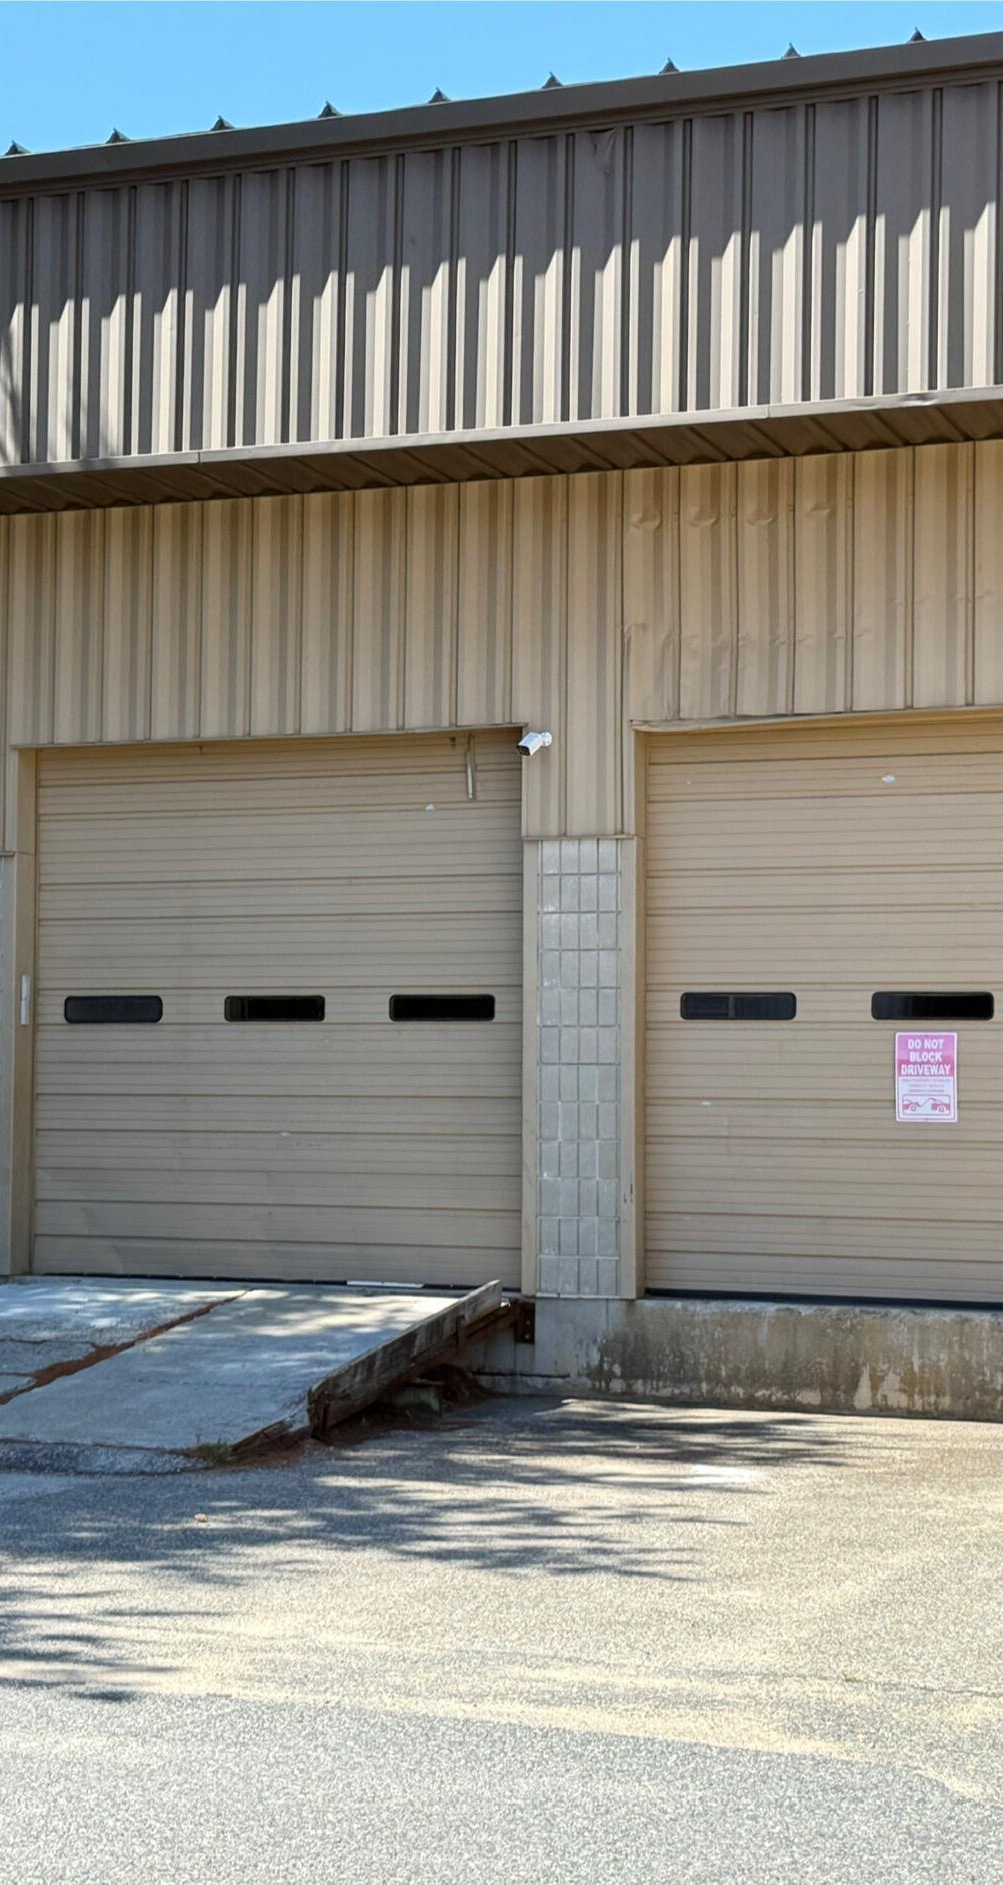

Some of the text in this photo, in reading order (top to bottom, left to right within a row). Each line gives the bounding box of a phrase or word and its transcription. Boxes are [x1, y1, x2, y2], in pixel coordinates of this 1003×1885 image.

[907, 1038, 944, 1049] DO NOT
[909, 1052, 942, 1062] BLOCK
[900, 1064, 951, 1075] DRIVEWAY
